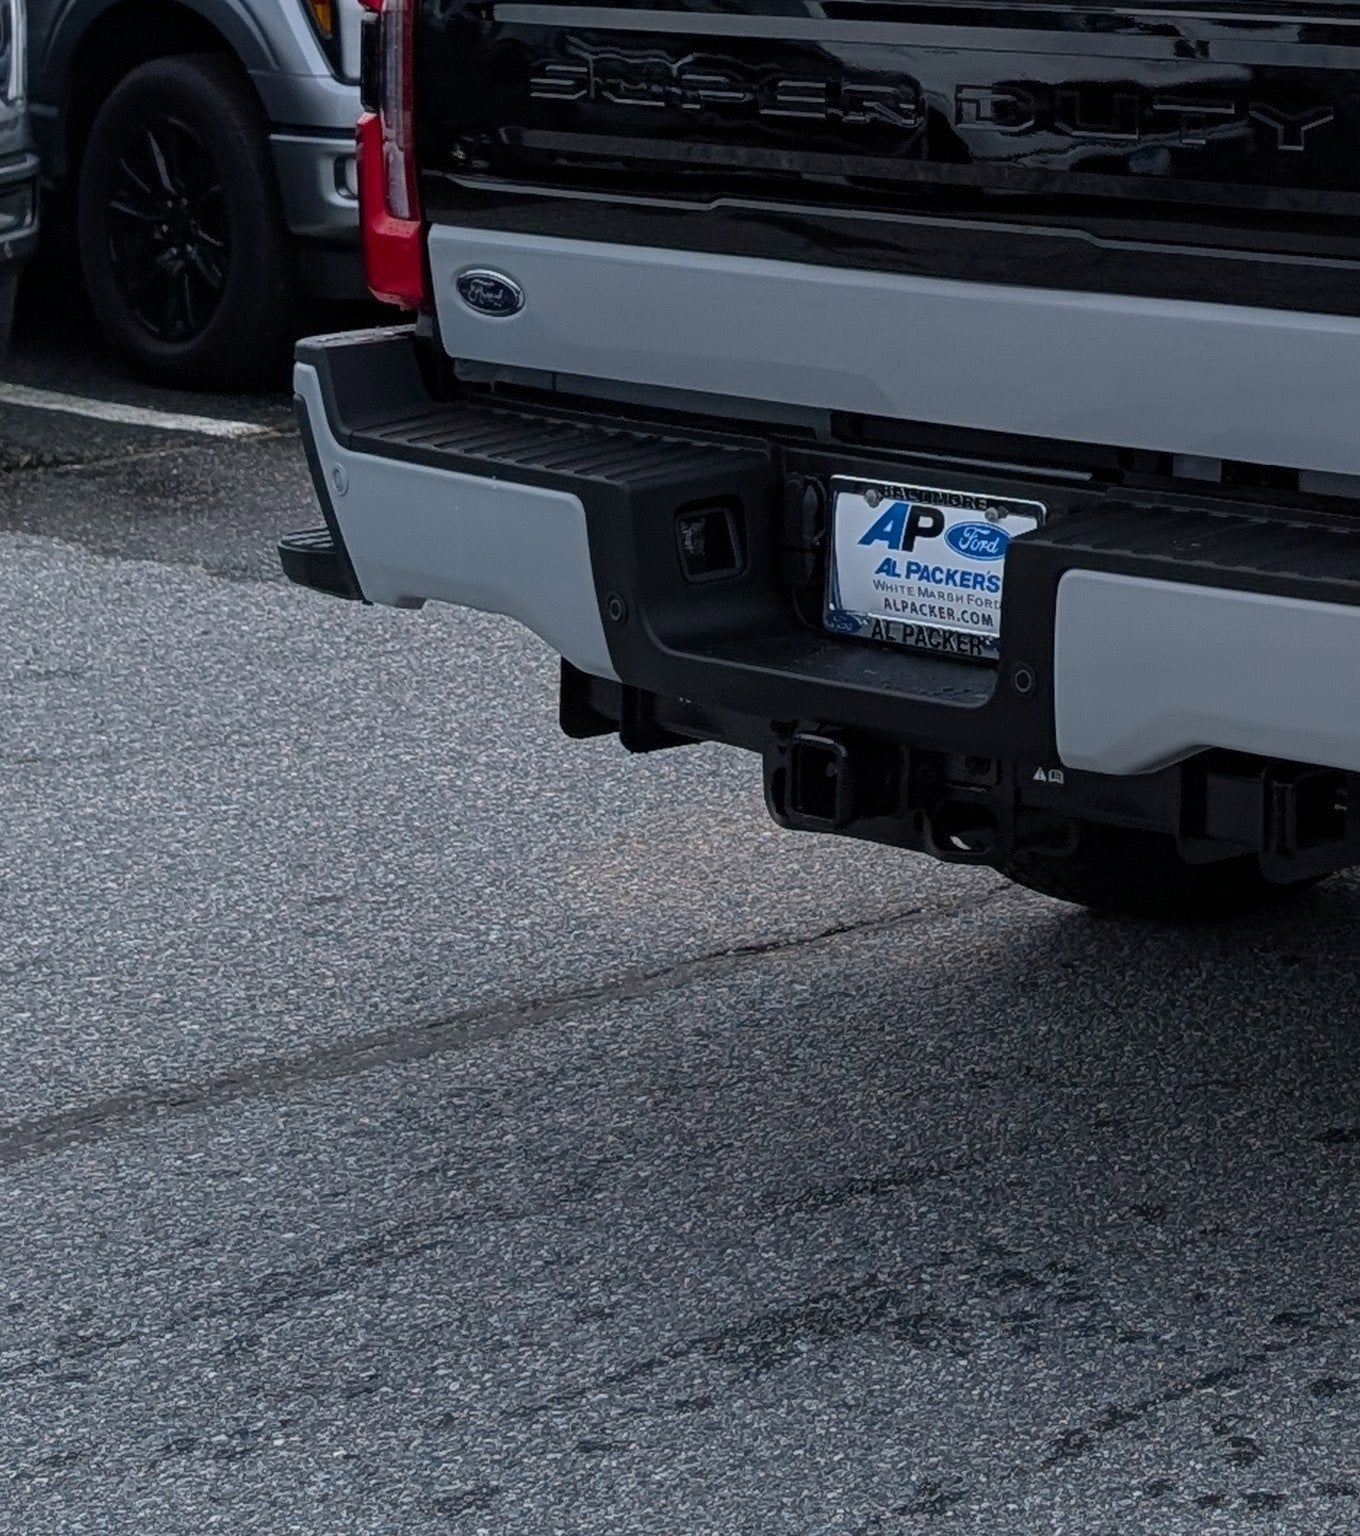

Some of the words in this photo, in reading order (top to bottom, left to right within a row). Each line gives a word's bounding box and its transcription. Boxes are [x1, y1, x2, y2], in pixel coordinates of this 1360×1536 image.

[955, 83, 1334, 151] DUTY
[857, 501, 945, 552] AP
[874, 557, 901, 579] AL
[905, 560, 1001, 594] PACKER'S
[884, 597, 994, 628] ALPACKER.COM
[871, 619, 897, 641] AL
[902, 623, 982, 655] PACKER
